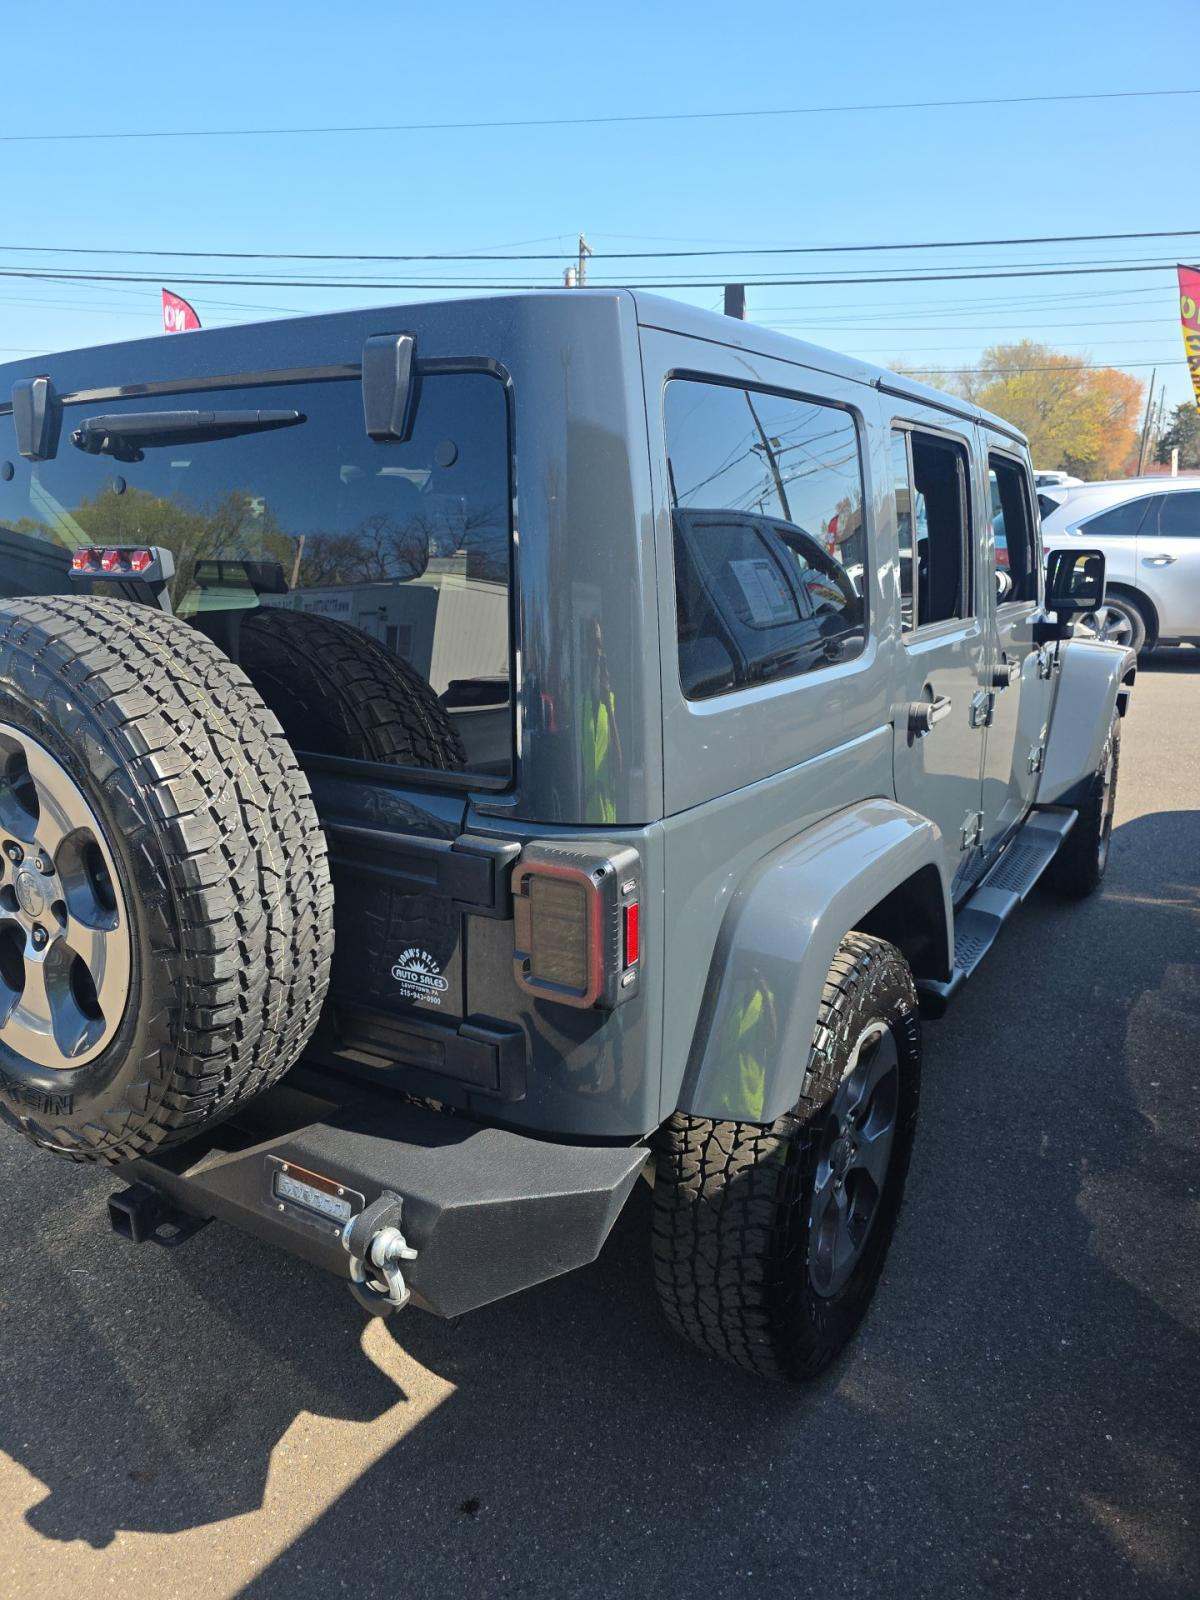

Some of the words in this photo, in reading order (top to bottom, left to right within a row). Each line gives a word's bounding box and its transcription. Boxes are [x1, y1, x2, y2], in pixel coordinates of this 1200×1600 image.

[398, 949, 420, 966] JOHN'S
[431, 962, 440, 974] 13
[396, 969, 418, 981] AUTO
[420, 975, 443, 988] SALES
